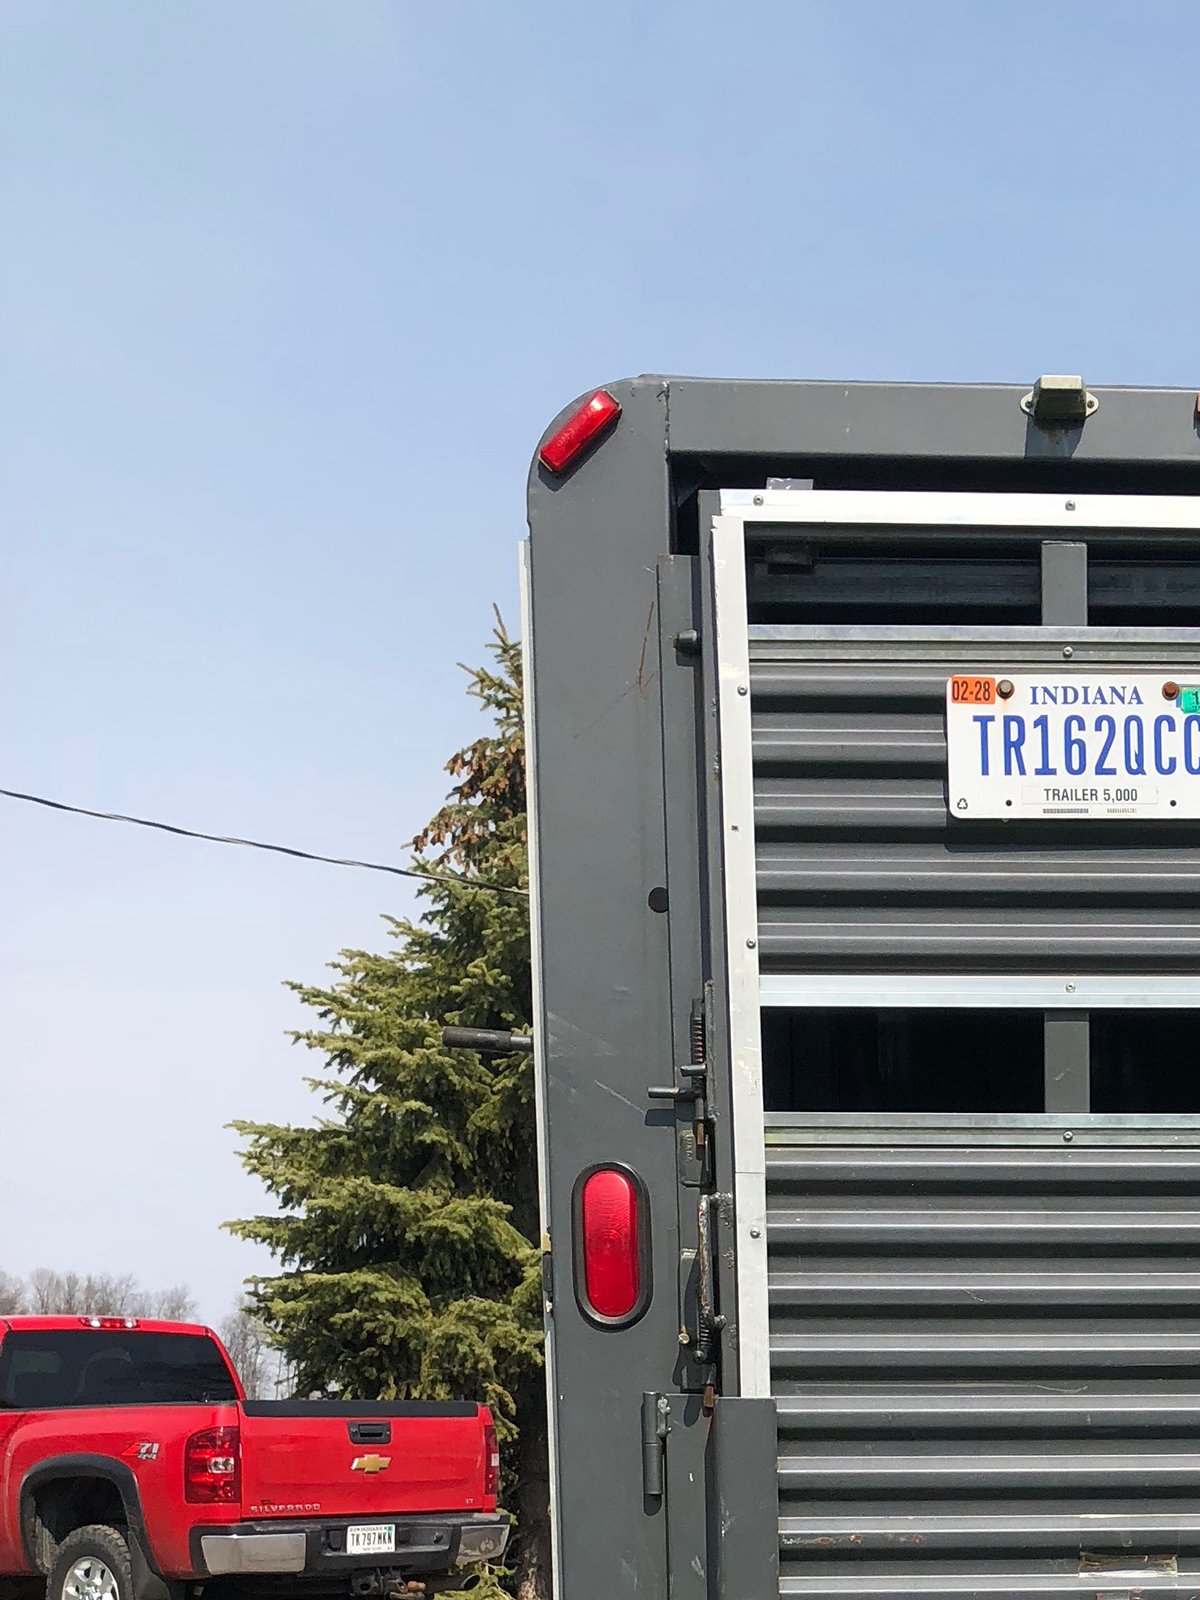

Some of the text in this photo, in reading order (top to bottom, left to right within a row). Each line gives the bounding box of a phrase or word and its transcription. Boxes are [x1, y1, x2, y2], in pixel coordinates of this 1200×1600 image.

[951, 680, 991, 702] 02-28
[1030, 686, 1144, 705] INDIANA
[1044, 788, 1138, 803] TRAILER 5,000
